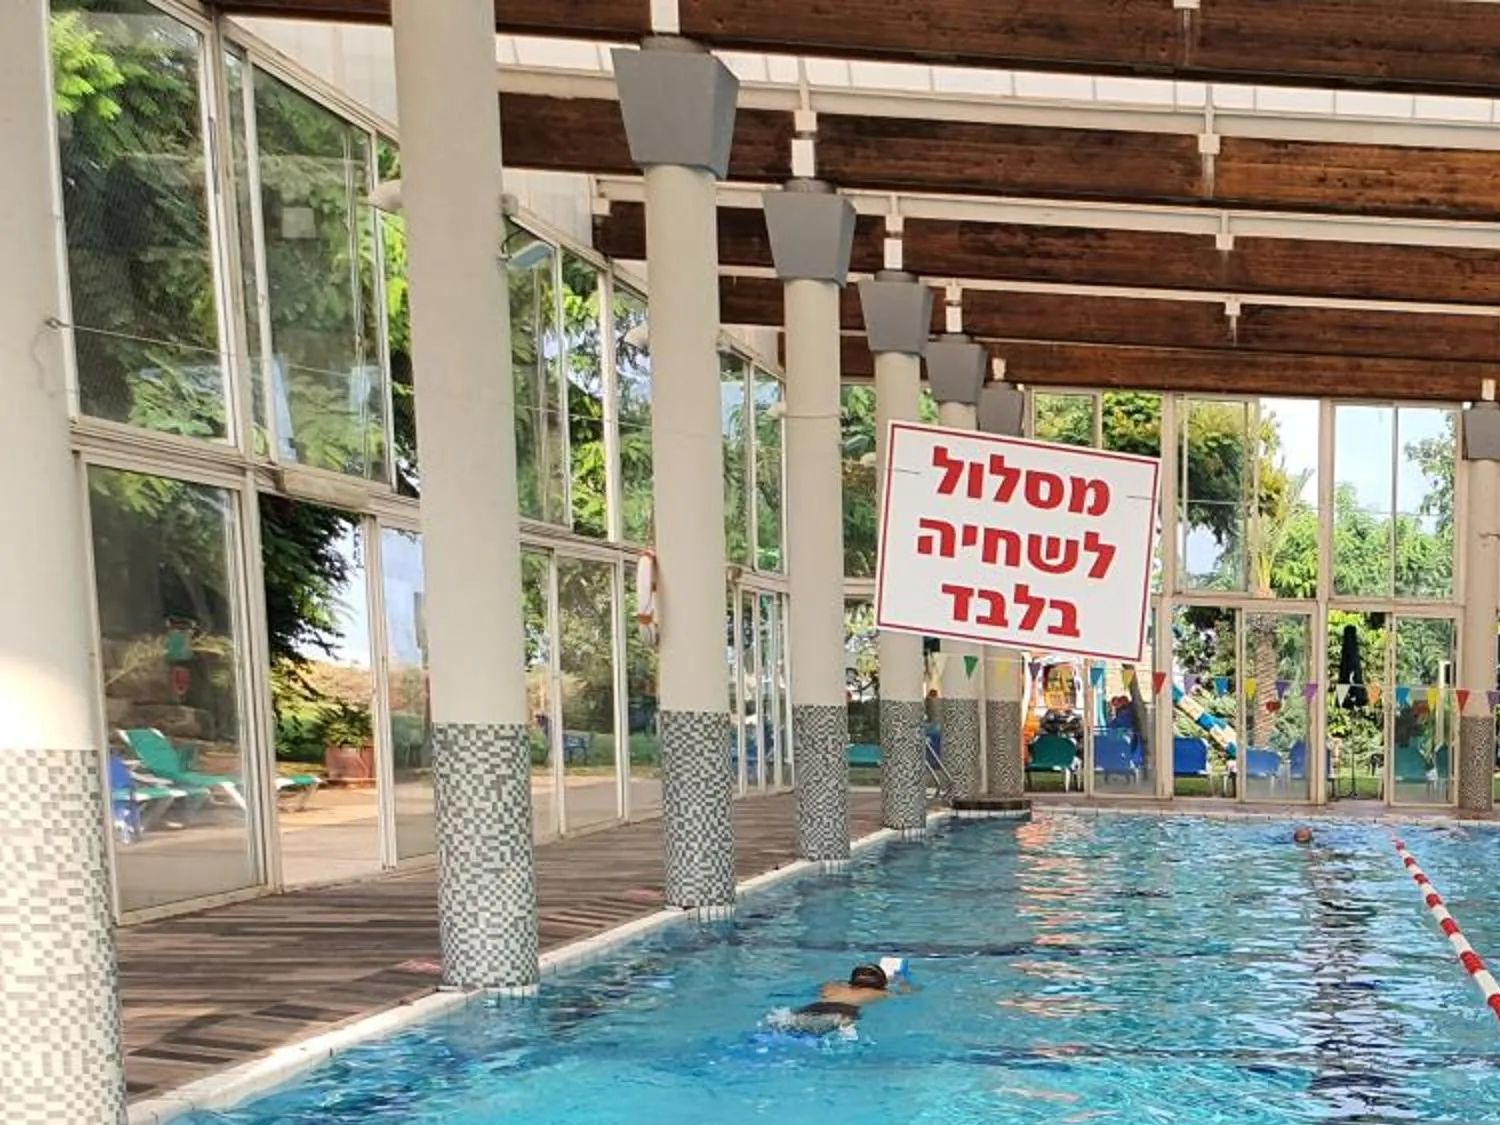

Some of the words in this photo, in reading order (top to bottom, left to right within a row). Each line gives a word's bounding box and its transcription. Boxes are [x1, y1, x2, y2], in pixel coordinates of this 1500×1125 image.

[932, 446, 1111, 516] מסלול
[917, 517, 1117, 580] לשחיה
[941, 583, 1081, 638] בלבד
